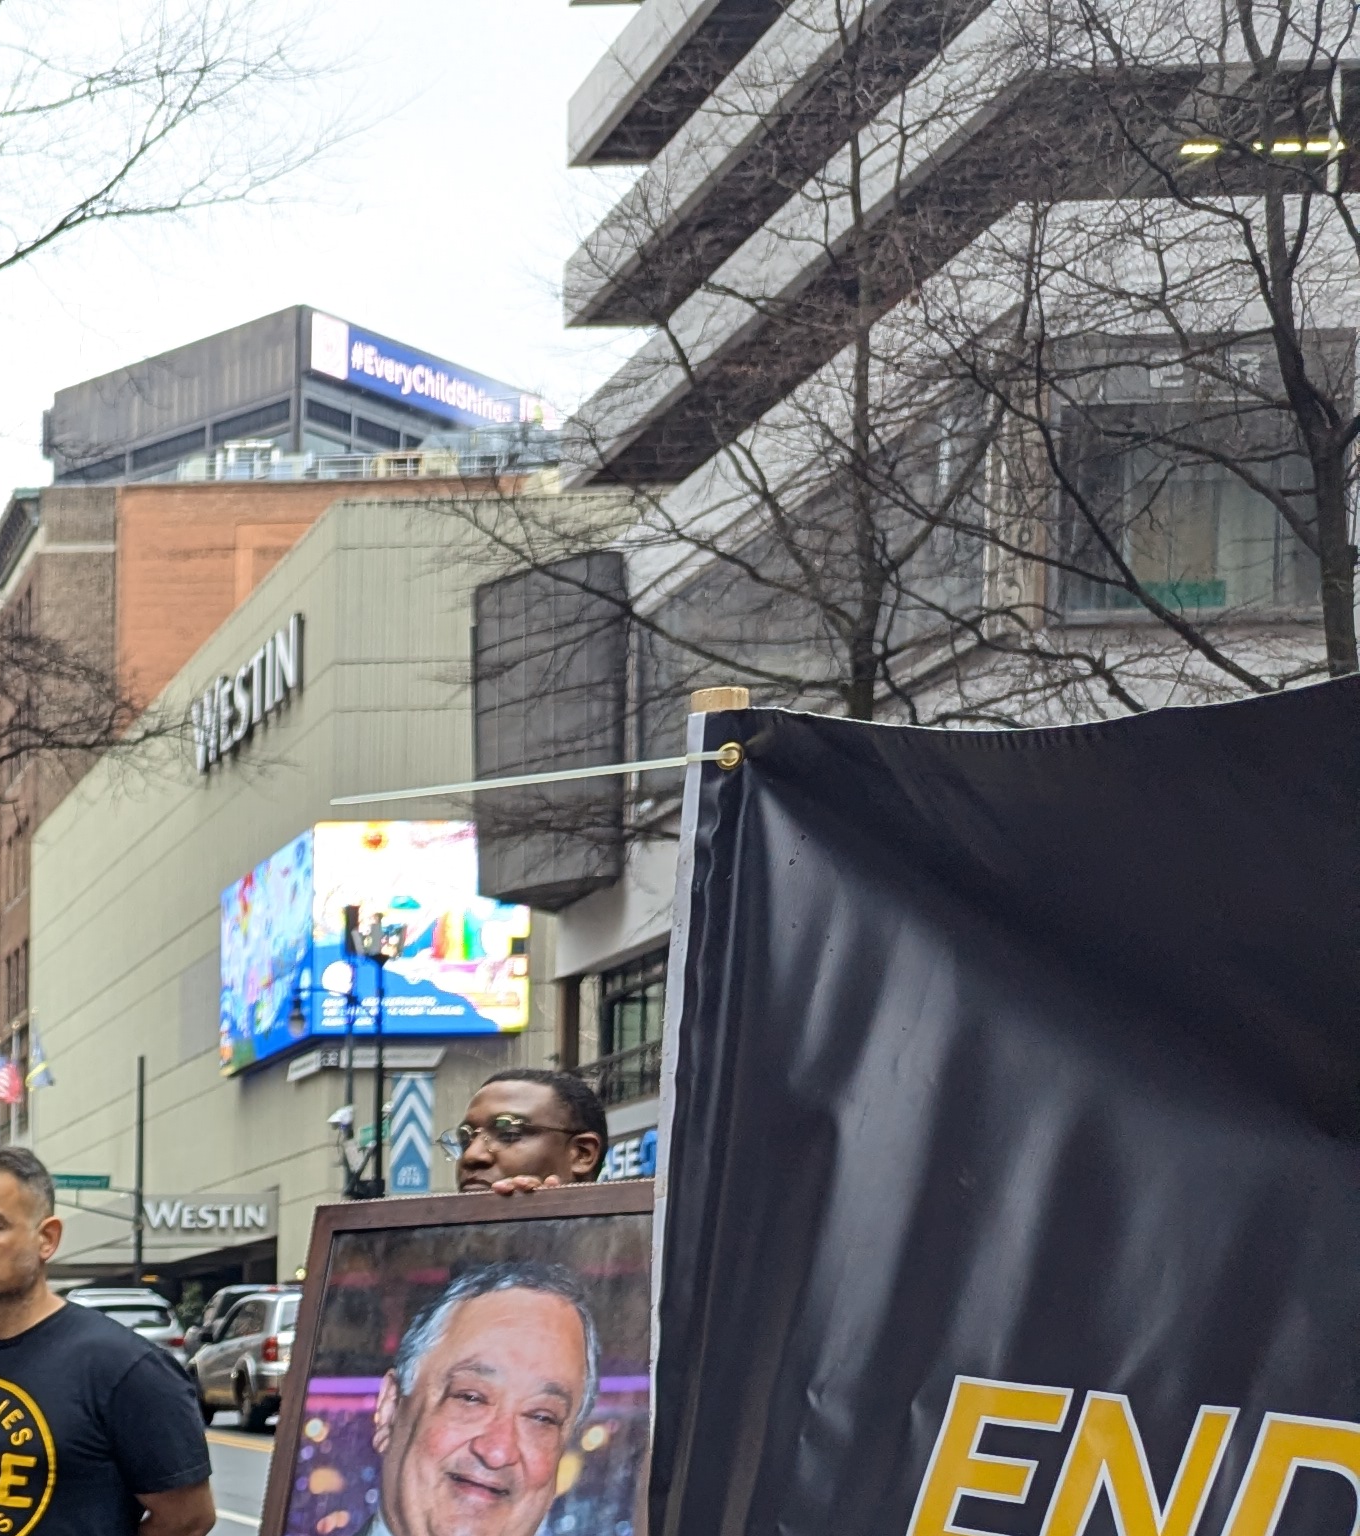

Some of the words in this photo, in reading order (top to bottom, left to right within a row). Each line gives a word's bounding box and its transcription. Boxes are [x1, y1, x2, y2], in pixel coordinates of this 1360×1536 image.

[191, 613, 303, 776] WESTIN
[596, 1137, 642, 1183] ASE
[142, 1200, 267, 1228] WESTIN
